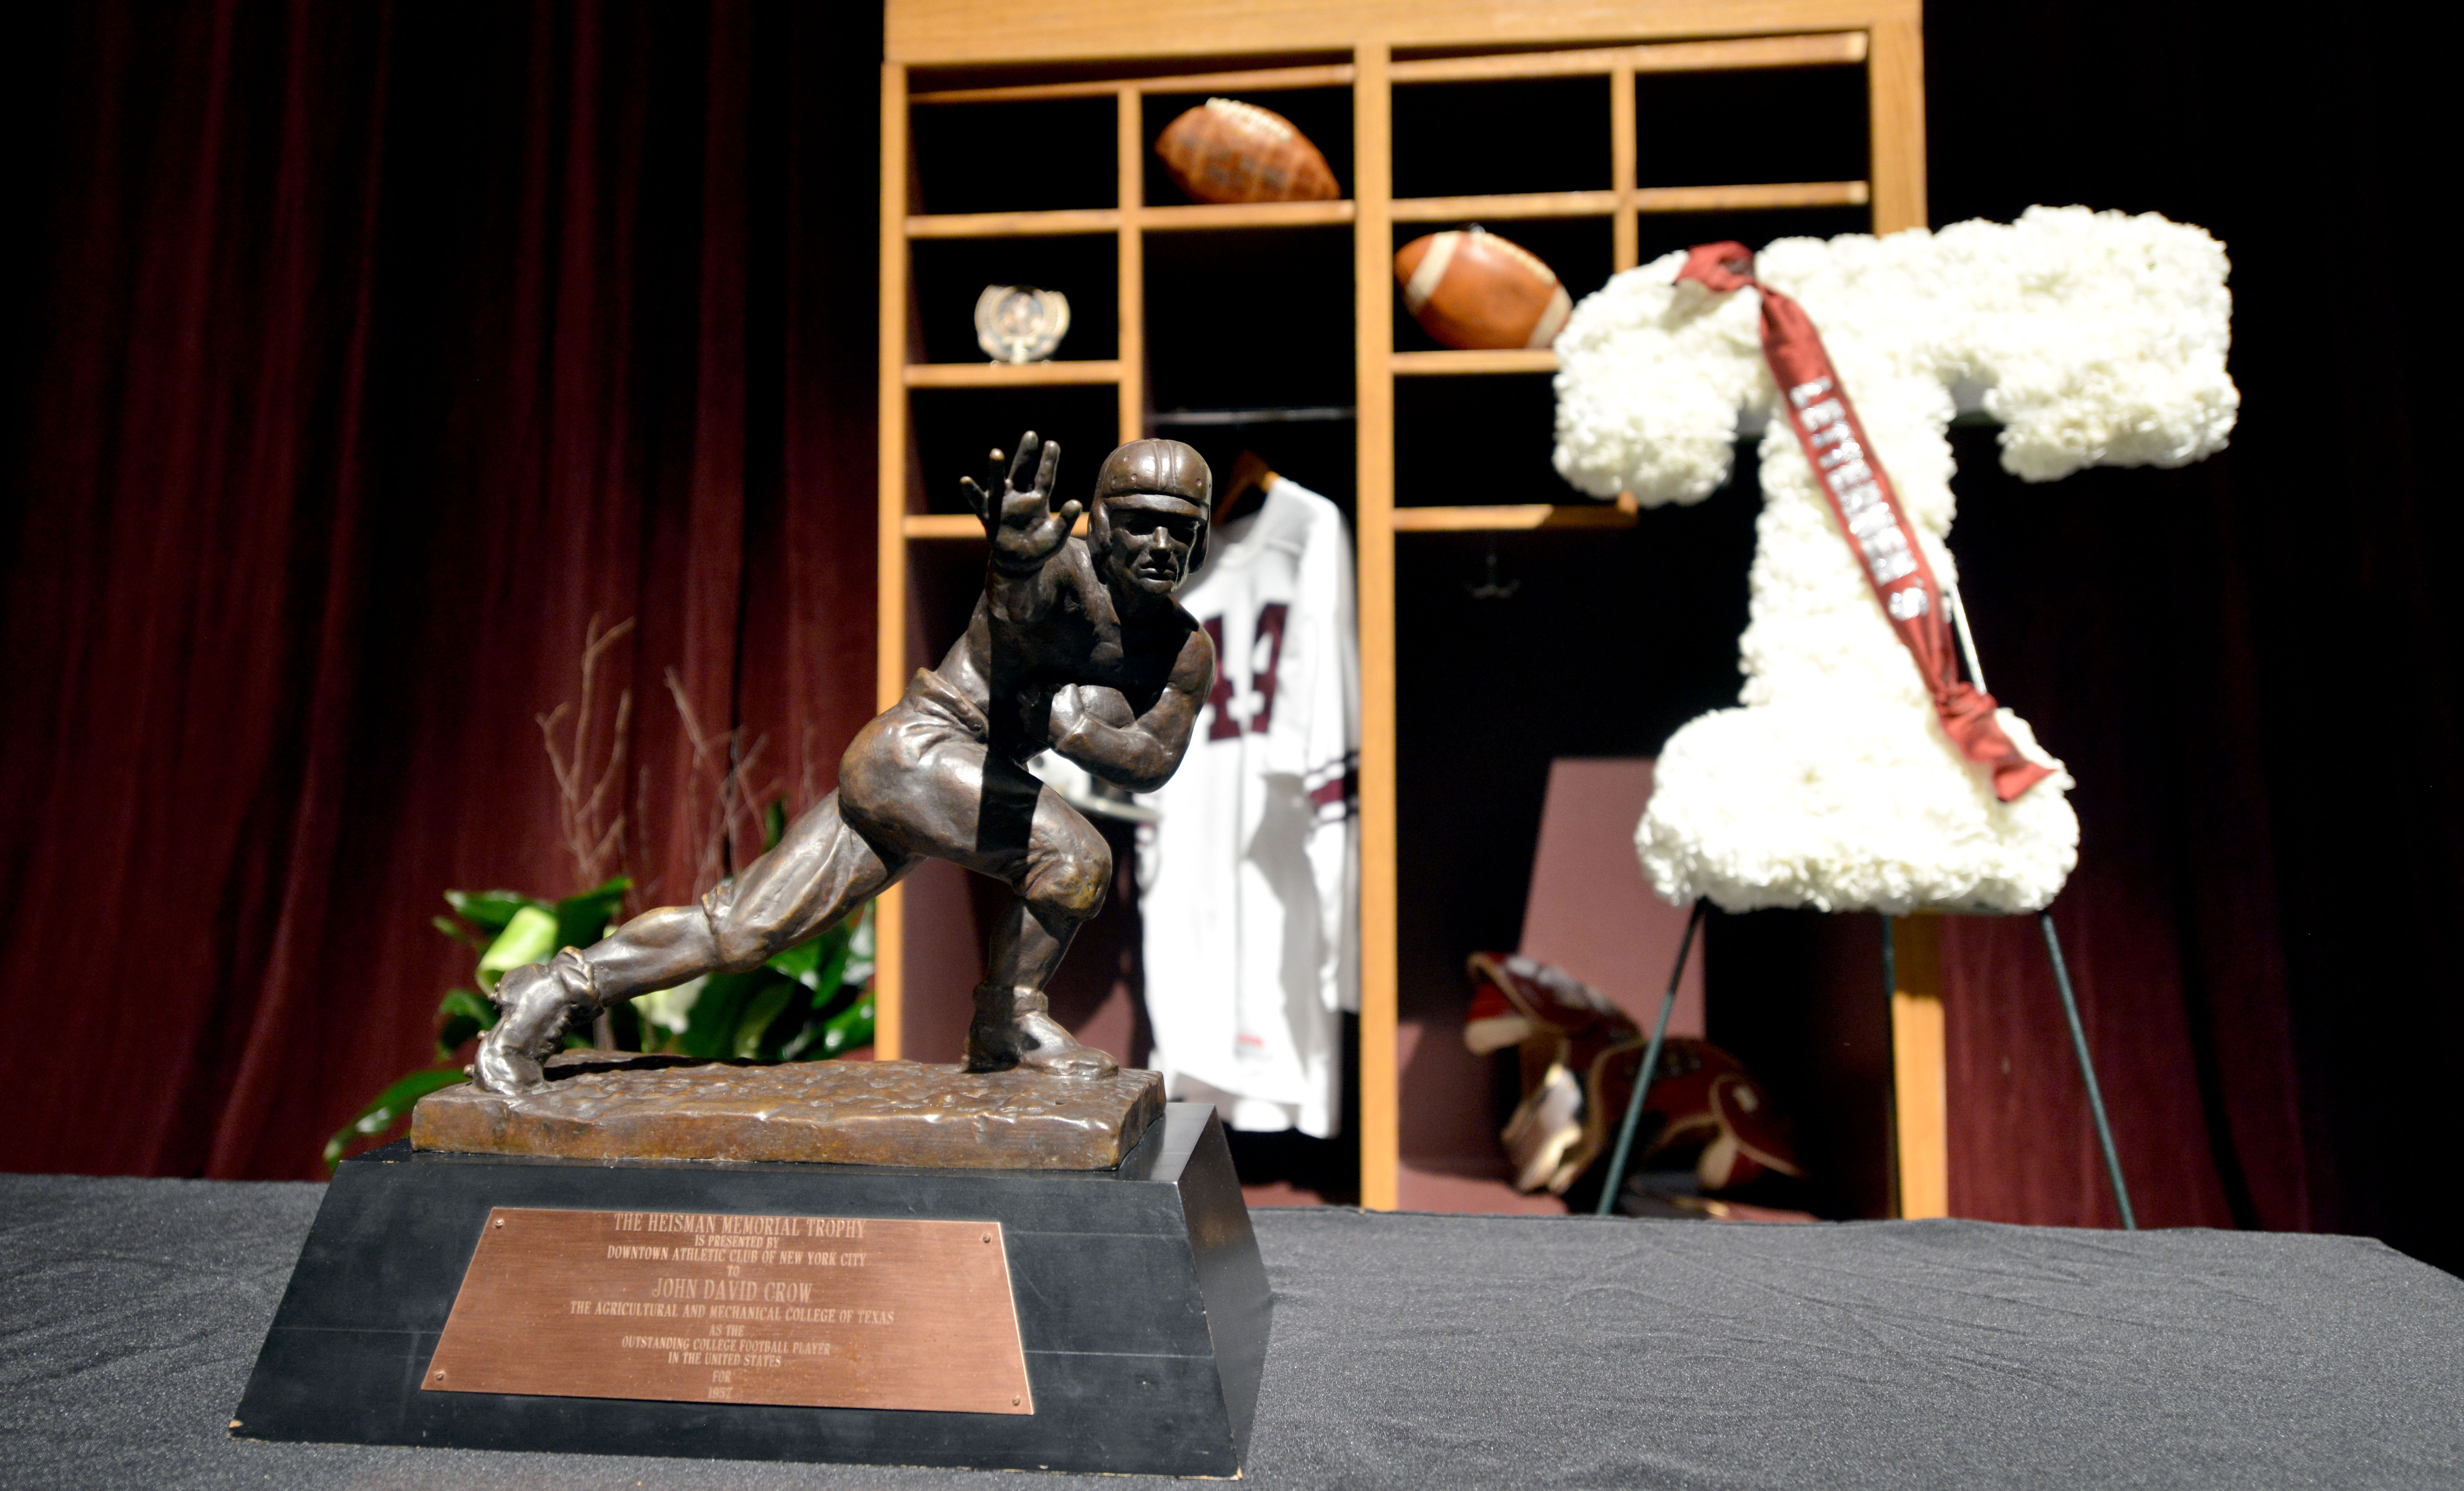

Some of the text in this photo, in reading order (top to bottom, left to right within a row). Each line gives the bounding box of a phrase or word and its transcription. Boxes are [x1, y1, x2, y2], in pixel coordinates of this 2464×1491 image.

[614, 1213, 866, 1238] THE HEISMAN MEMORIAL TROPHY
[694, 1234, 779, 1249] IS PRESENTED BY
[607, 1245, 866, 1267] DOWNTOWN ATHLETIC CLUB OF NEW YORK CITY
[727, 1265, 740, 1277] TO
[651, 1277, 813, 1303] JOHN DAVID CROW
[570, 1300, 895, 1325] THE AGRICULTURAL AND MECHANICAL COLLEGE OF TEXAS
[709, 1324, 745, 1337] AS THE
[622, 1335, 831, 1356] OUTSTANDING COLLEGE FOOTBALL PLAYER
[668, 1351, 783, 1368] IN THE UNITED STATES
[712, 1370, 732, 1383] FOR
[707, 1386, 734, 1400] 1957
